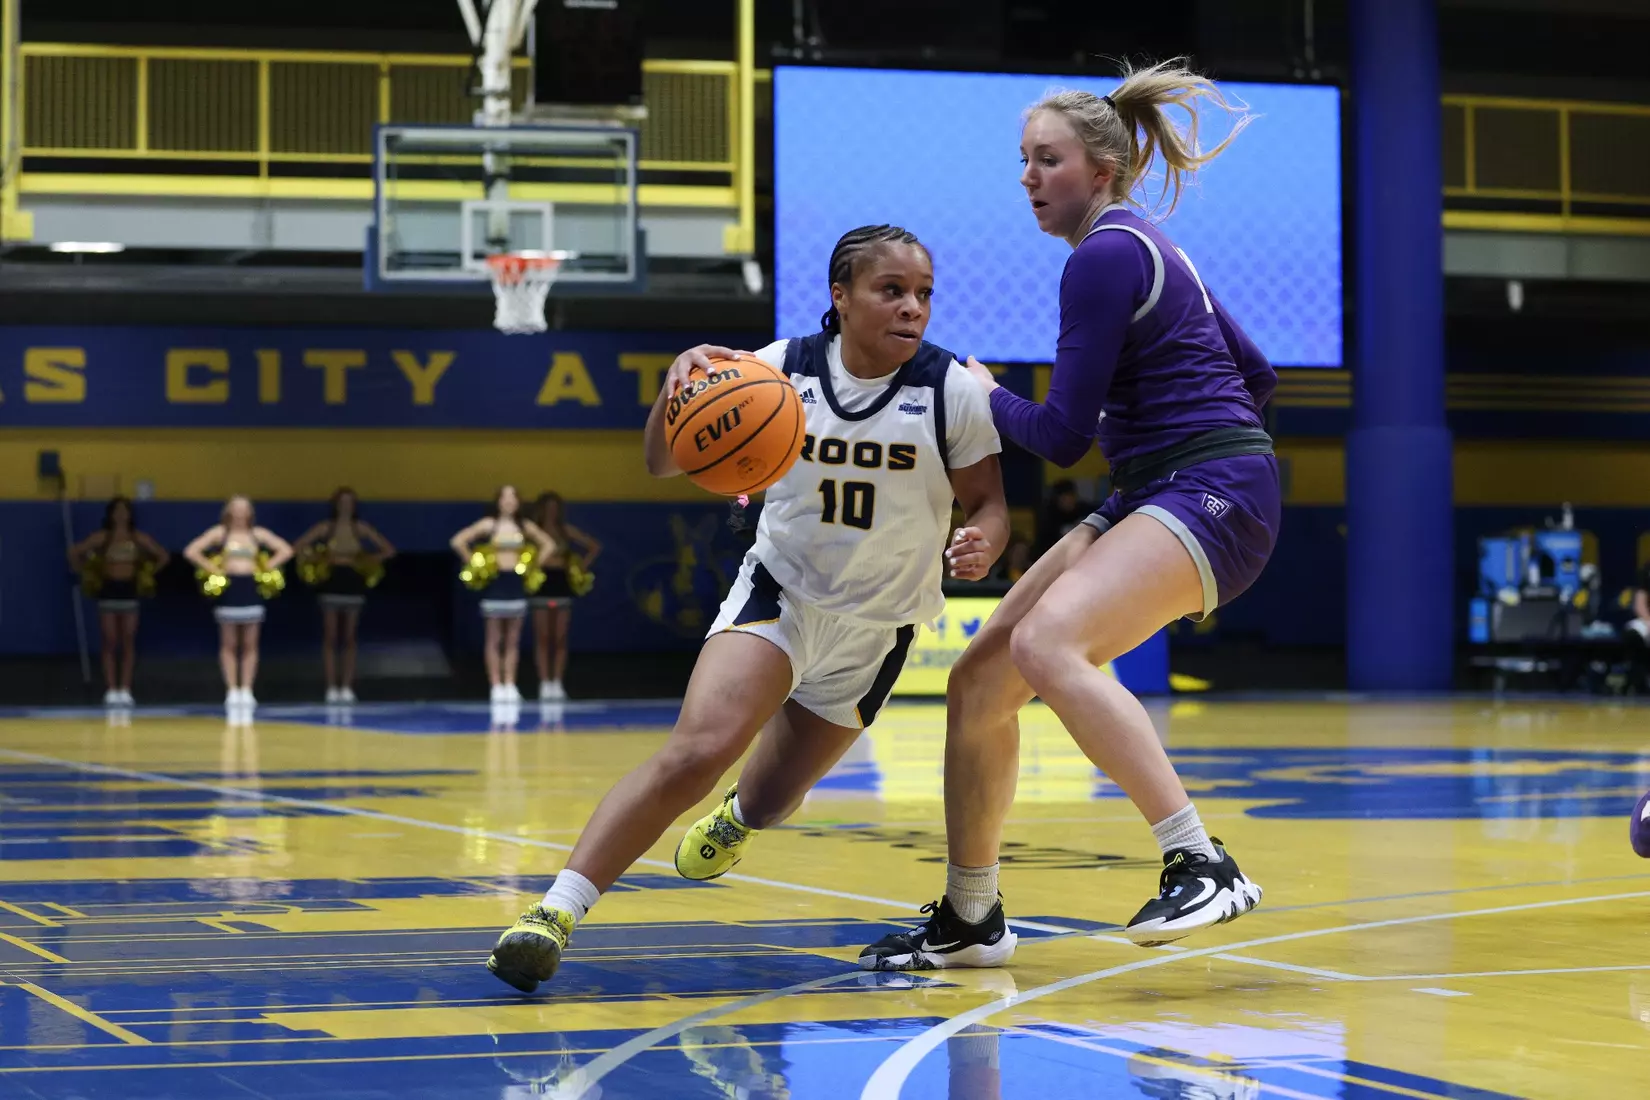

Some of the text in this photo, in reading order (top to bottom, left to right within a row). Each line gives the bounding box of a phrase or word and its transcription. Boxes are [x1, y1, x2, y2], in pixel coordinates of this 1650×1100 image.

[0, 347, 87, 404] S
[164, 348, 458, 405] CITY
[694, 406, 742, 453] EVO
[818, 478, 876, 531] 10
